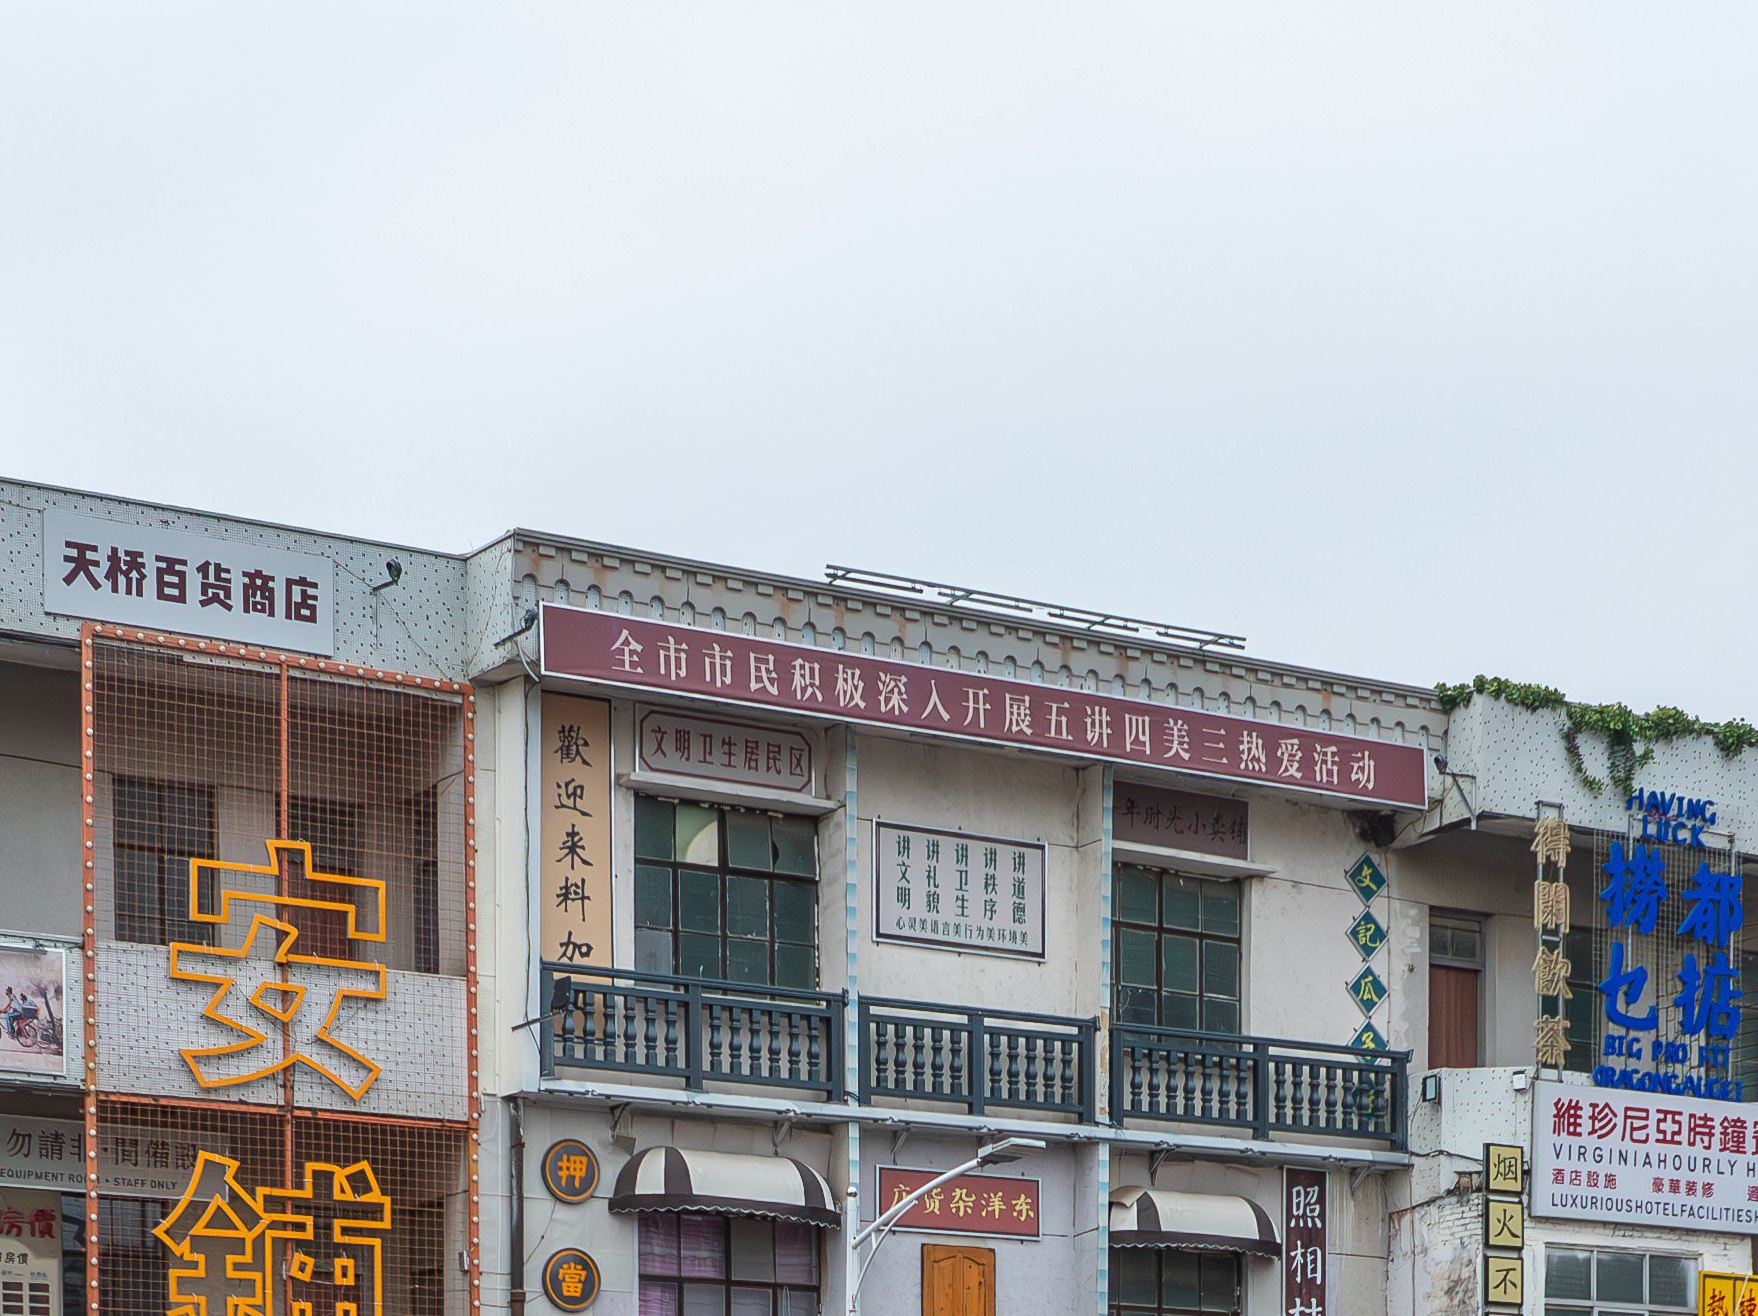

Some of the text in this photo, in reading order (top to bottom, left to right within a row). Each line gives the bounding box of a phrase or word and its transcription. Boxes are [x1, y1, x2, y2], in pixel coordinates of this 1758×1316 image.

[61, 539, 321, 626] 天桥百货商店
[609, 627, 1377, 792] 全市市民积极深入开展五讲四美三热爱活动
[650, 725, 806, 778] 文明卫生居民区
[896, 834, 911, 911] 讲文明
[925, 838, 940, 915] 讲礼貌
[954, 842, 969, 919] 讲卫生
[983, 846, 998, 922] 讲秩序
[1011, 850, 1026, 926] 讲道德
[0, 1167, 65, 1182] EQUIPMENT
